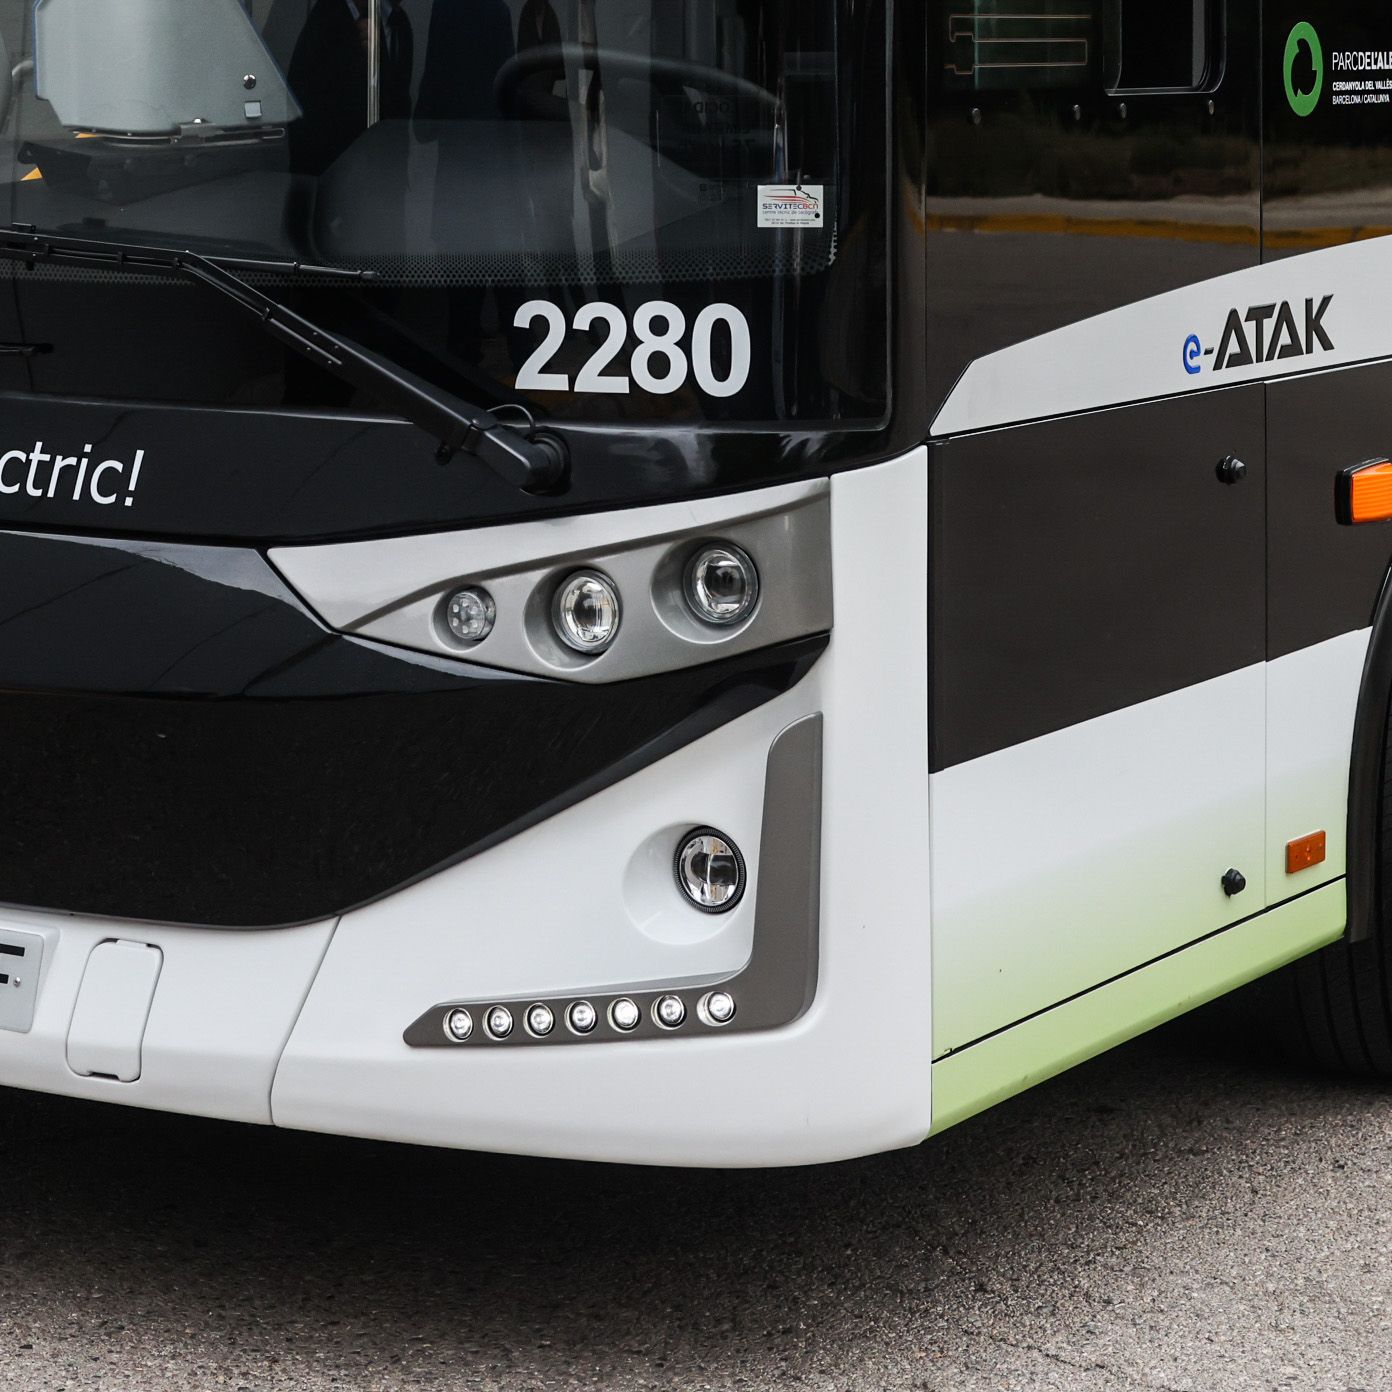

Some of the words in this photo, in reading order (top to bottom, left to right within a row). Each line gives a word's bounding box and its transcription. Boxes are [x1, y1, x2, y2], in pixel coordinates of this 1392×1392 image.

[1365, 80, 1375, 90] DEL
[512, 299, 752, 398] 2280
[1182, 293, 1336, 375] e-ATAK
